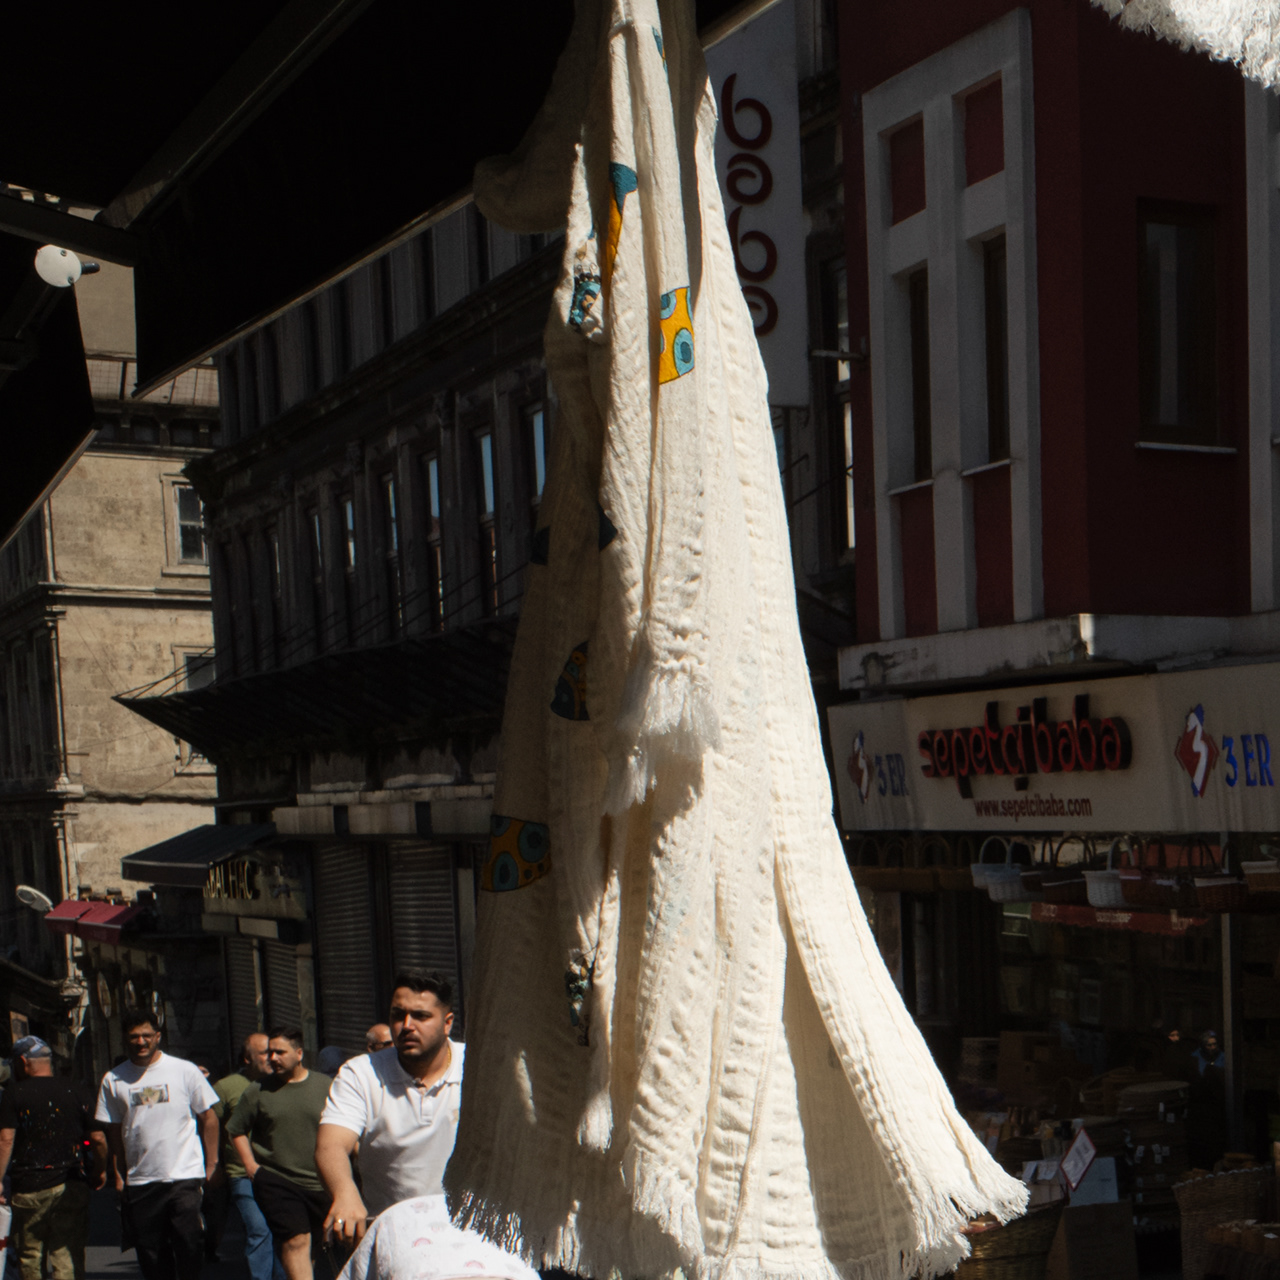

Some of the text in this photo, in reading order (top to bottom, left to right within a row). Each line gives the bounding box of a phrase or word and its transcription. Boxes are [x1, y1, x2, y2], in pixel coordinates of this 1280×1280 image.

[875, 753, 909, 797] 3 ER
[1222, 733, 1274, 788] 3 ER
[975, 793, 1092, 823] www.sepetcibaba.com
